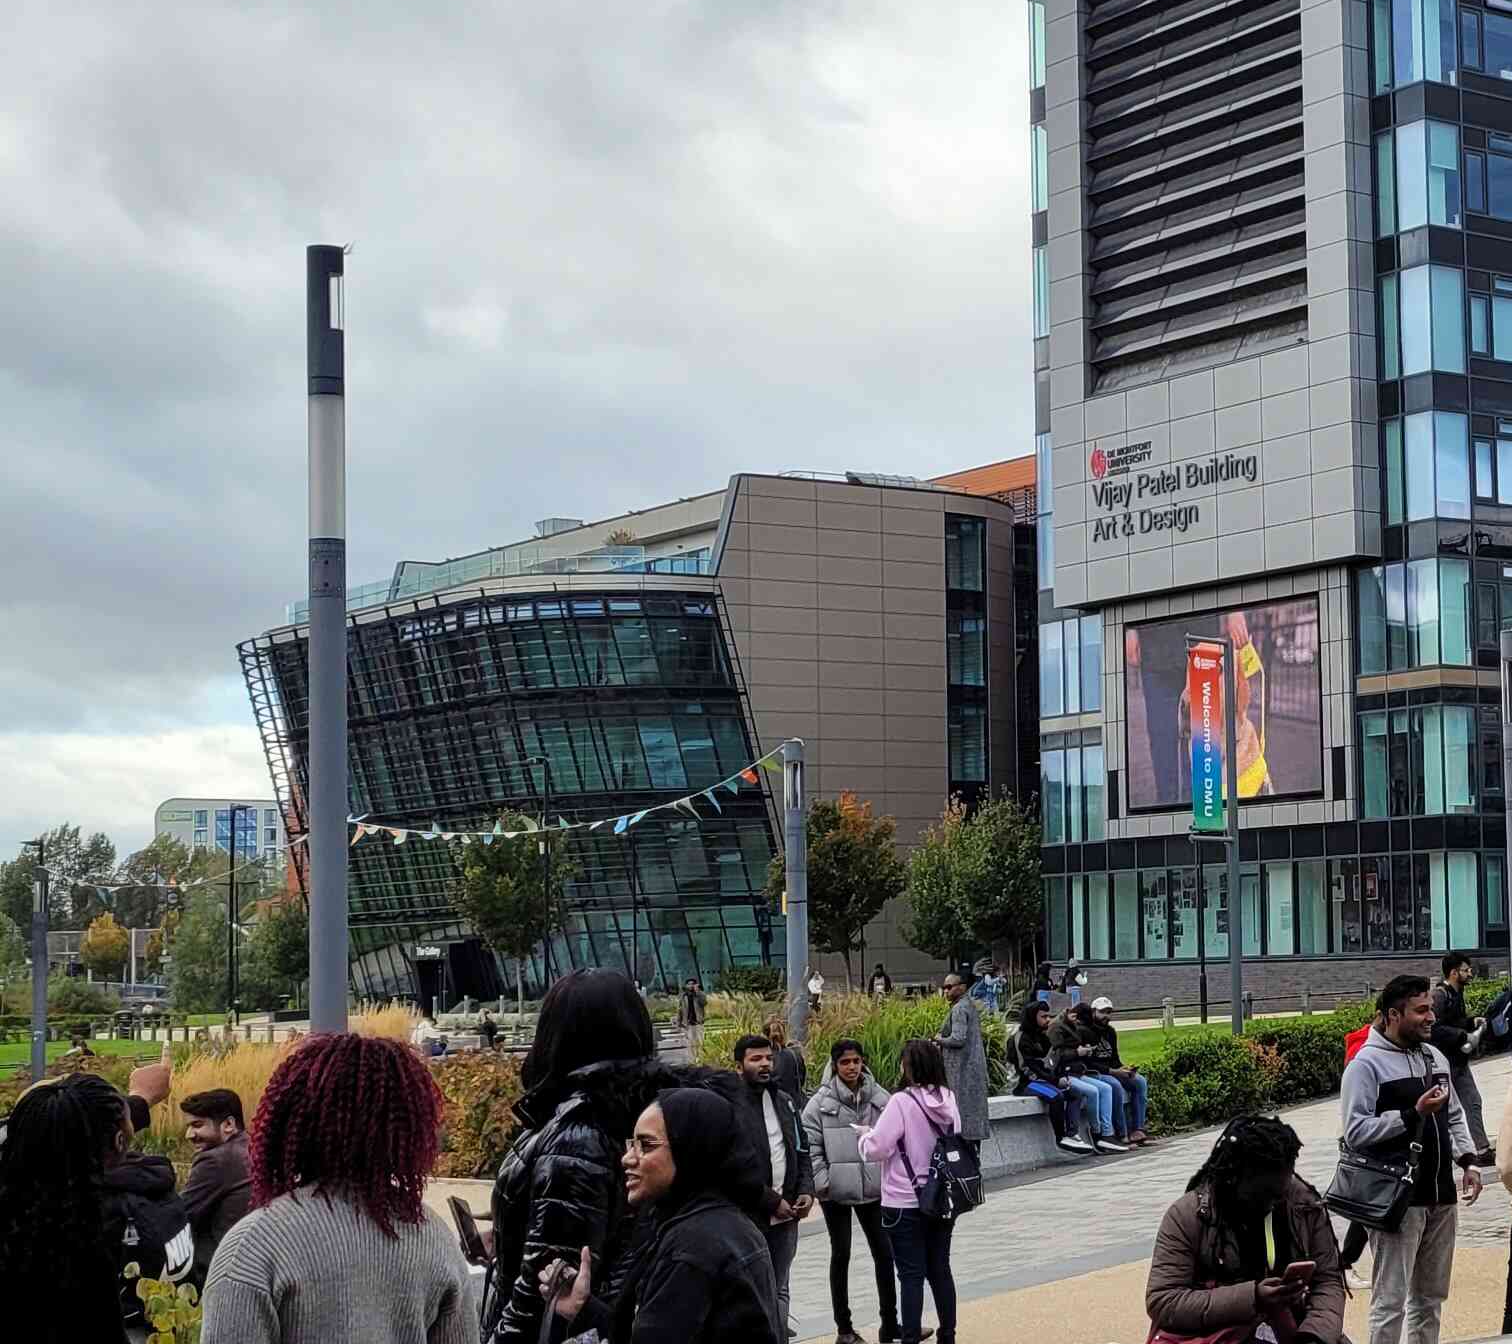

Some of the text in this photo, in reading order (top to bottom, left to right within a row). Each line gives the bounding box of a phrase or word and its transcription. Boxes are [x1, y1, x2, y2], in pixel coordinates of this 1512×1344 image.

[1092, 454, 1258, 512] Vijay Patel Building
[1107, 450, 1152, 468] UNIVERSITY
[1093, 503, 1200, 543] Art & Design
[1202, 681, 1213, 817] Welcome to DMU
